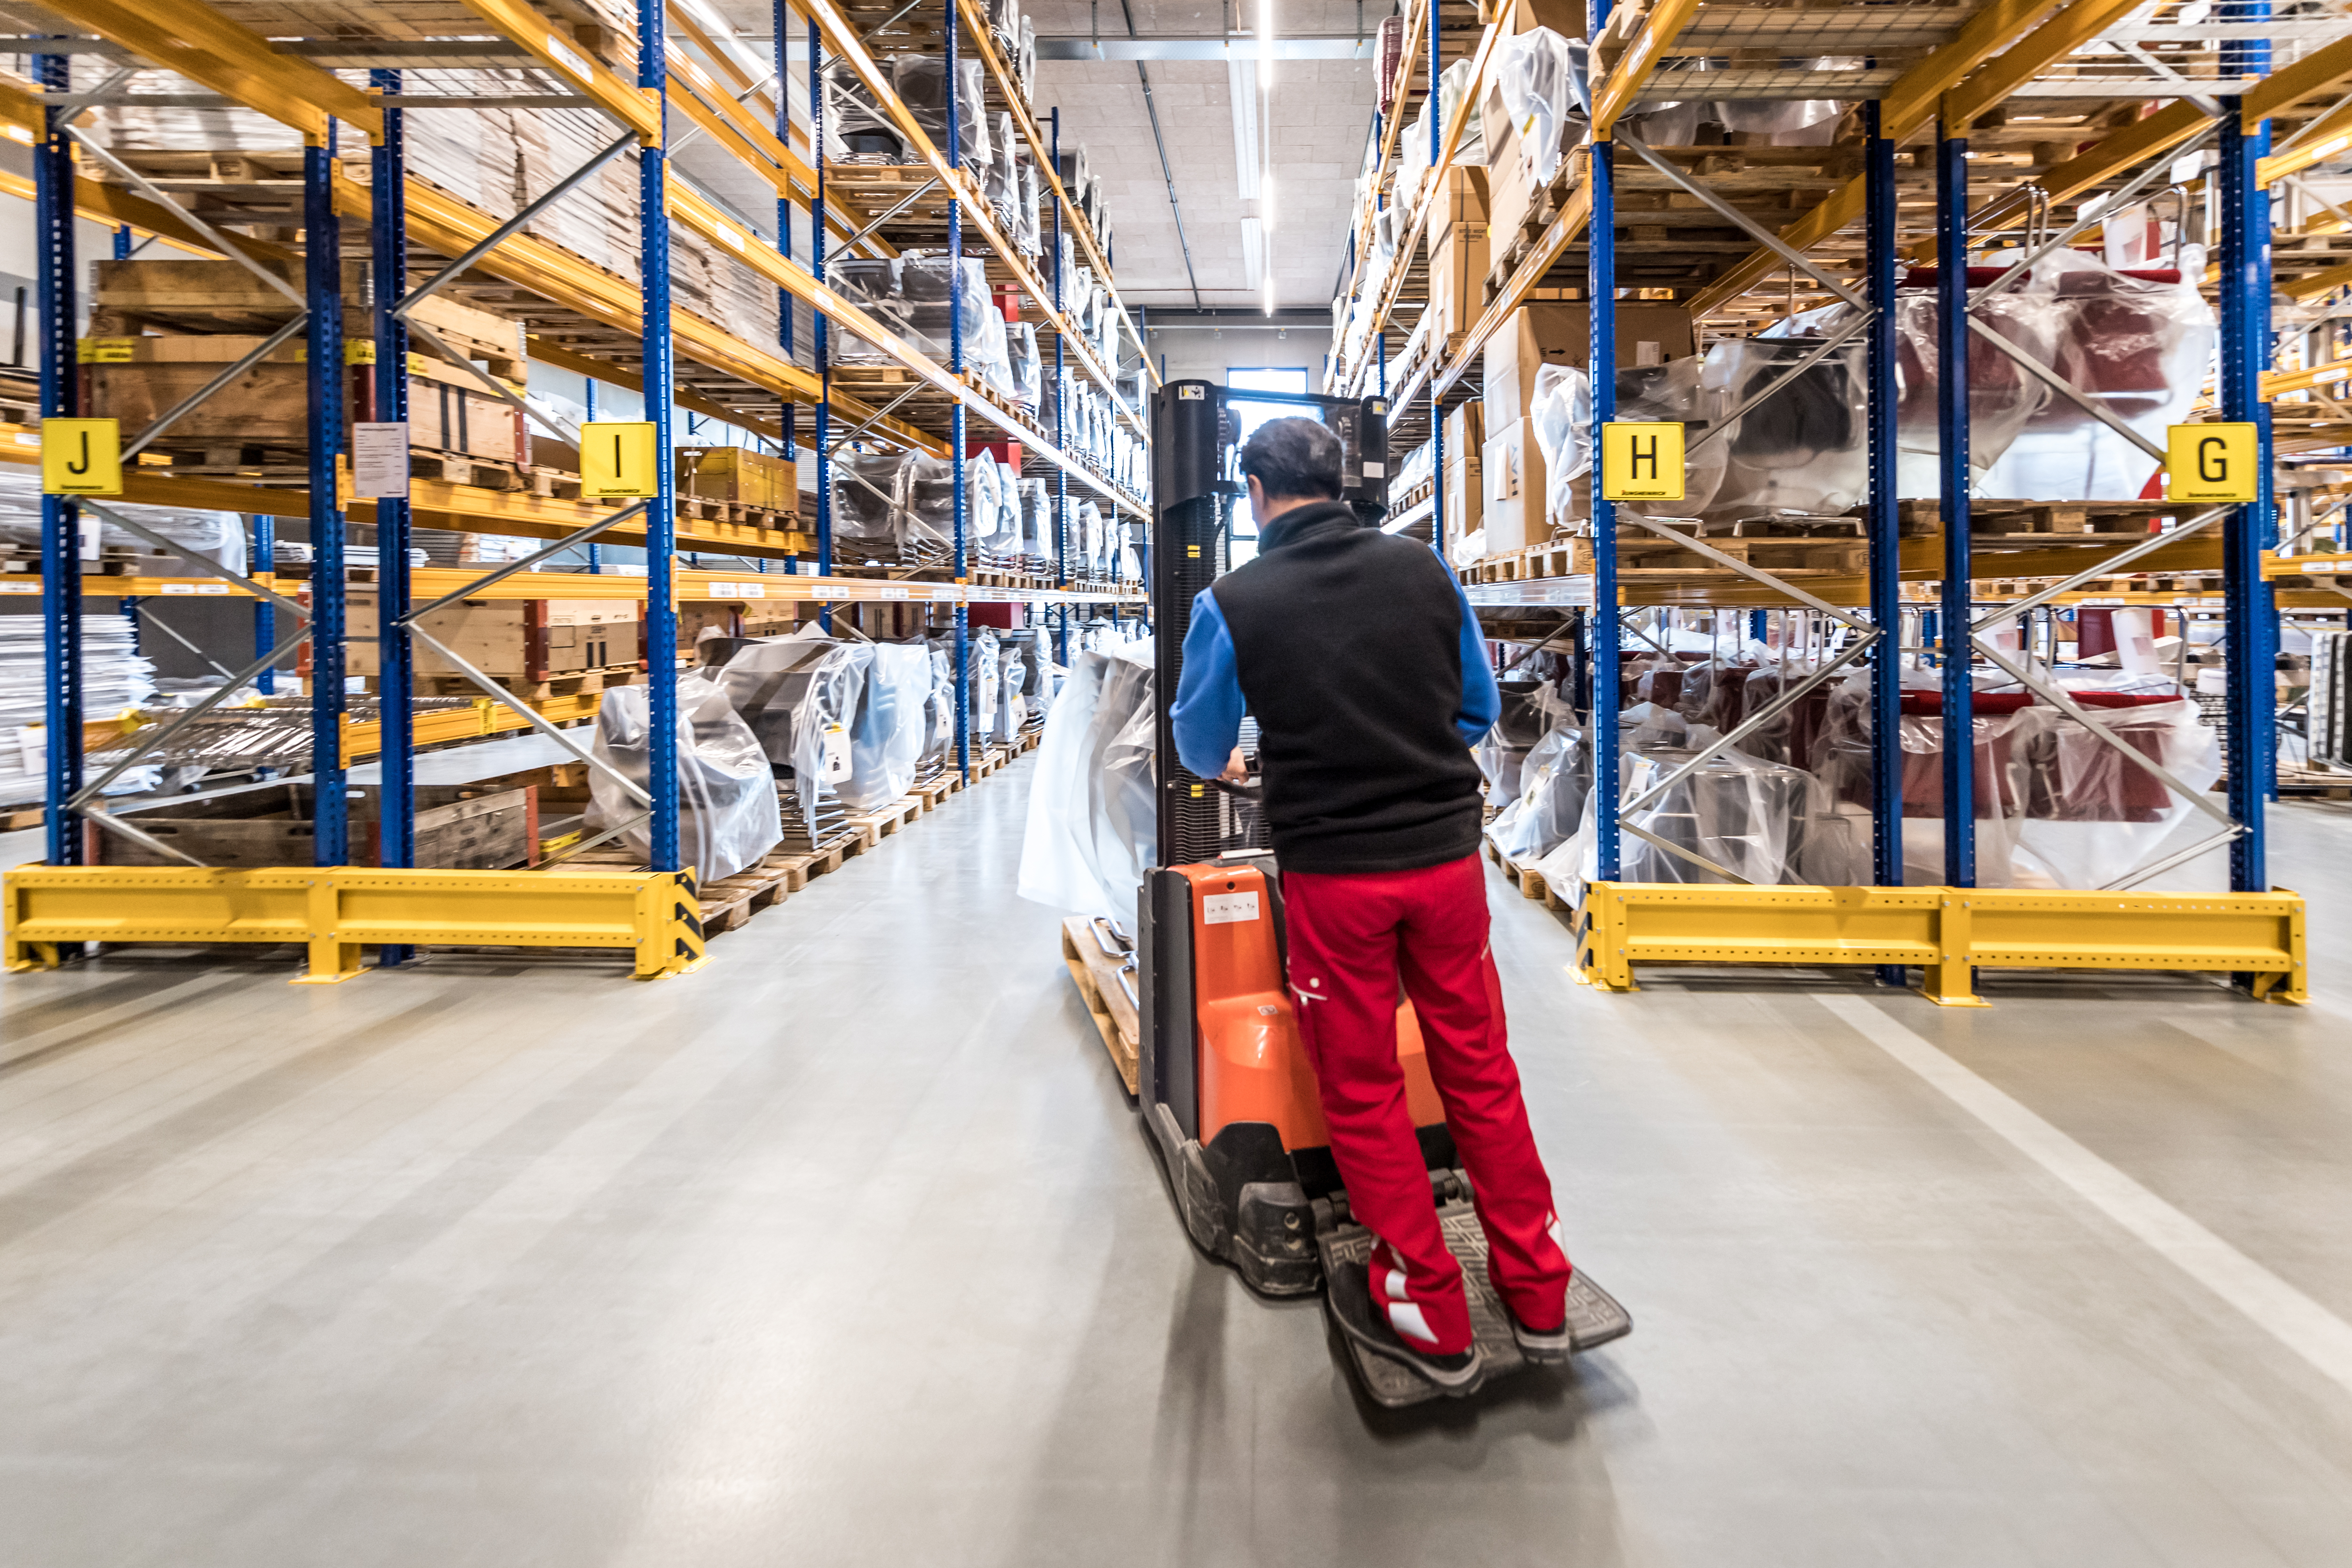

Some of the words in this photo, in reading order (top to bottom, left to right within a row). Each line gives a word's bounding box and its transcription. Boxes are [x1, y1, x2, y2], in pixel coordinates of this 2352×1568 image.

[67, 431, 88, 475] J
[615, 435, 620, 477] I
[1631, 435, 1657, 479] H
[2198, 437, 2227, 482] G
